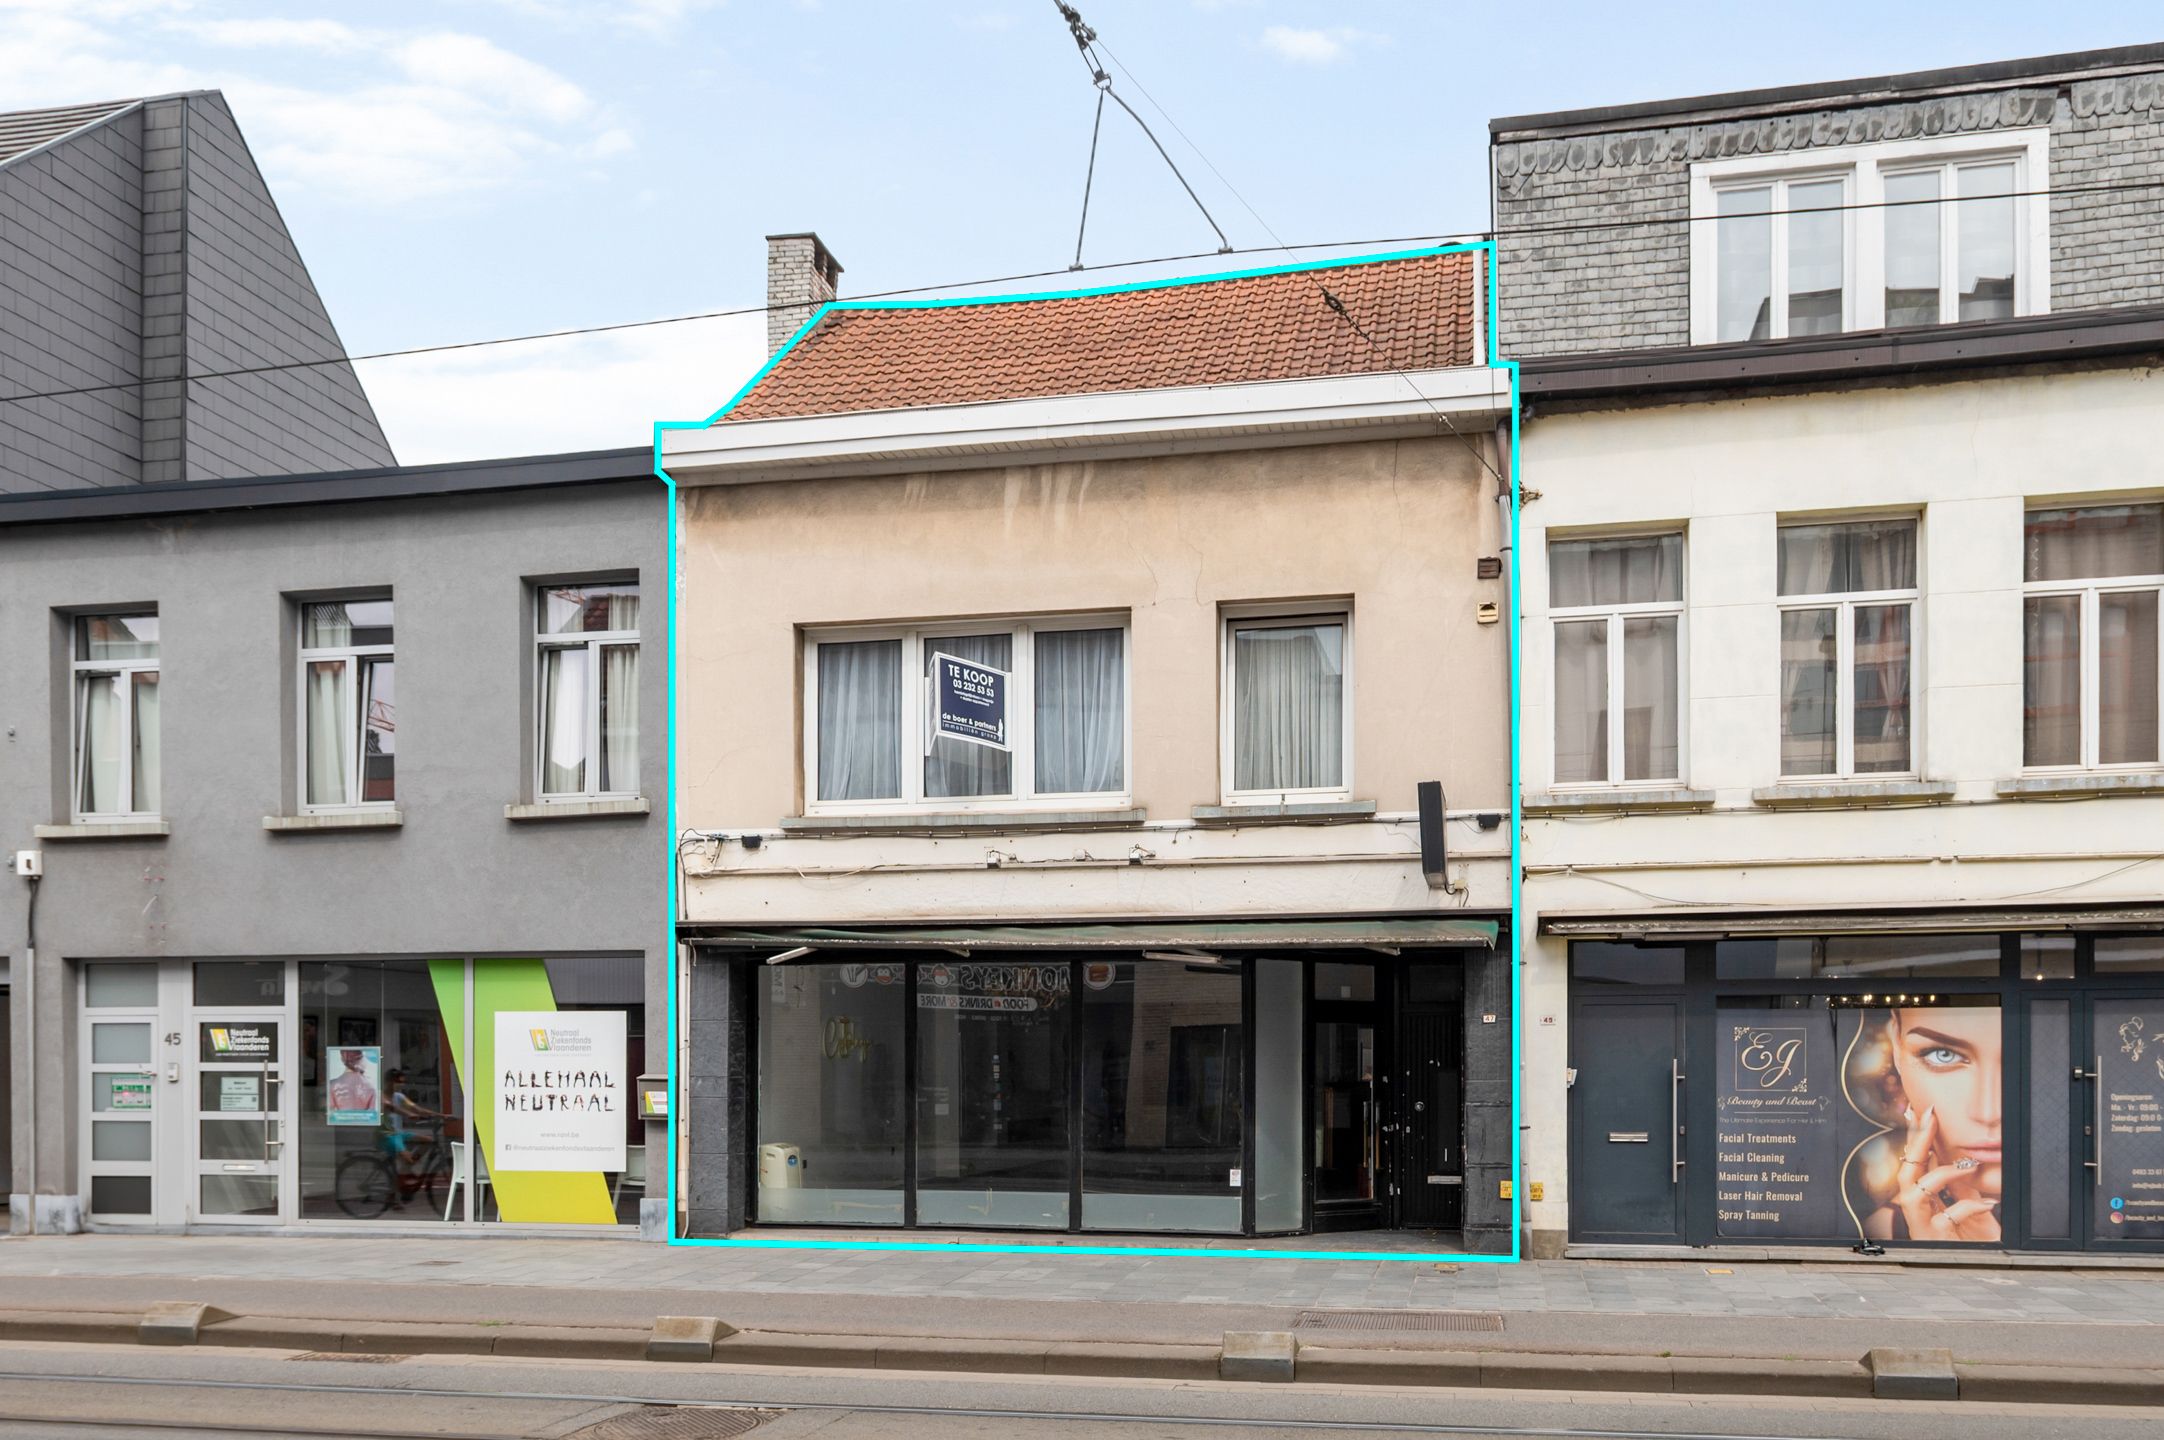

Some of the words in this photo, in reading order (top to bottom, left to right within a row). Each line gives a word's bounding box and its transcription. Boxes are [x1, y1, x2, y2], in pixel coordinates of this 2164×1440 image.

[948, 664, 960, 678] TE
[963, 668, 994, 687] KOOP
[953, 679, 962, 689] 03
[963, 681, 976, 693] 232
[976, 685, 985, 695] 53
[986, 687, 994, 698] 53
[942, 712, 951, 720] de
[952, 714, 968, 724] boer
[974, 720, 997, 732] partners
[164, 1033, 181, 1045] 45
[504, 1070, 616, 1088] ALLEMAAL
[504, 1094, 615, 1112] NEUTRAAL
[1727, 1096, 1763, 1108] Beauty
[1765, 1096, 1786, 1105] and
[1786, 1096, 1817, 1105] Beast
[1719, 1133, 1744, 1143] Facial
[1747, 1133, 1796, 1143] Treatments
[1719, 1152, 1744, 1162] Facial
[1747, 1152, 1784, 1165] Cleaning
[1719, 1172, 1758, 1182] Manicure
[1761, 1172, 1768, 1182] &
[1771, 1172, 1810, 1182] Pedicure
[1719, 1190, 1741, 1201] Laser
[1744, 1191, 1763, 1201] Hair
[1766, 1191, 1803, 1201] Removal
[1719, 1209, 1743, 1221] Spray
[1745, 1210, 1779, 1222] Tanning
